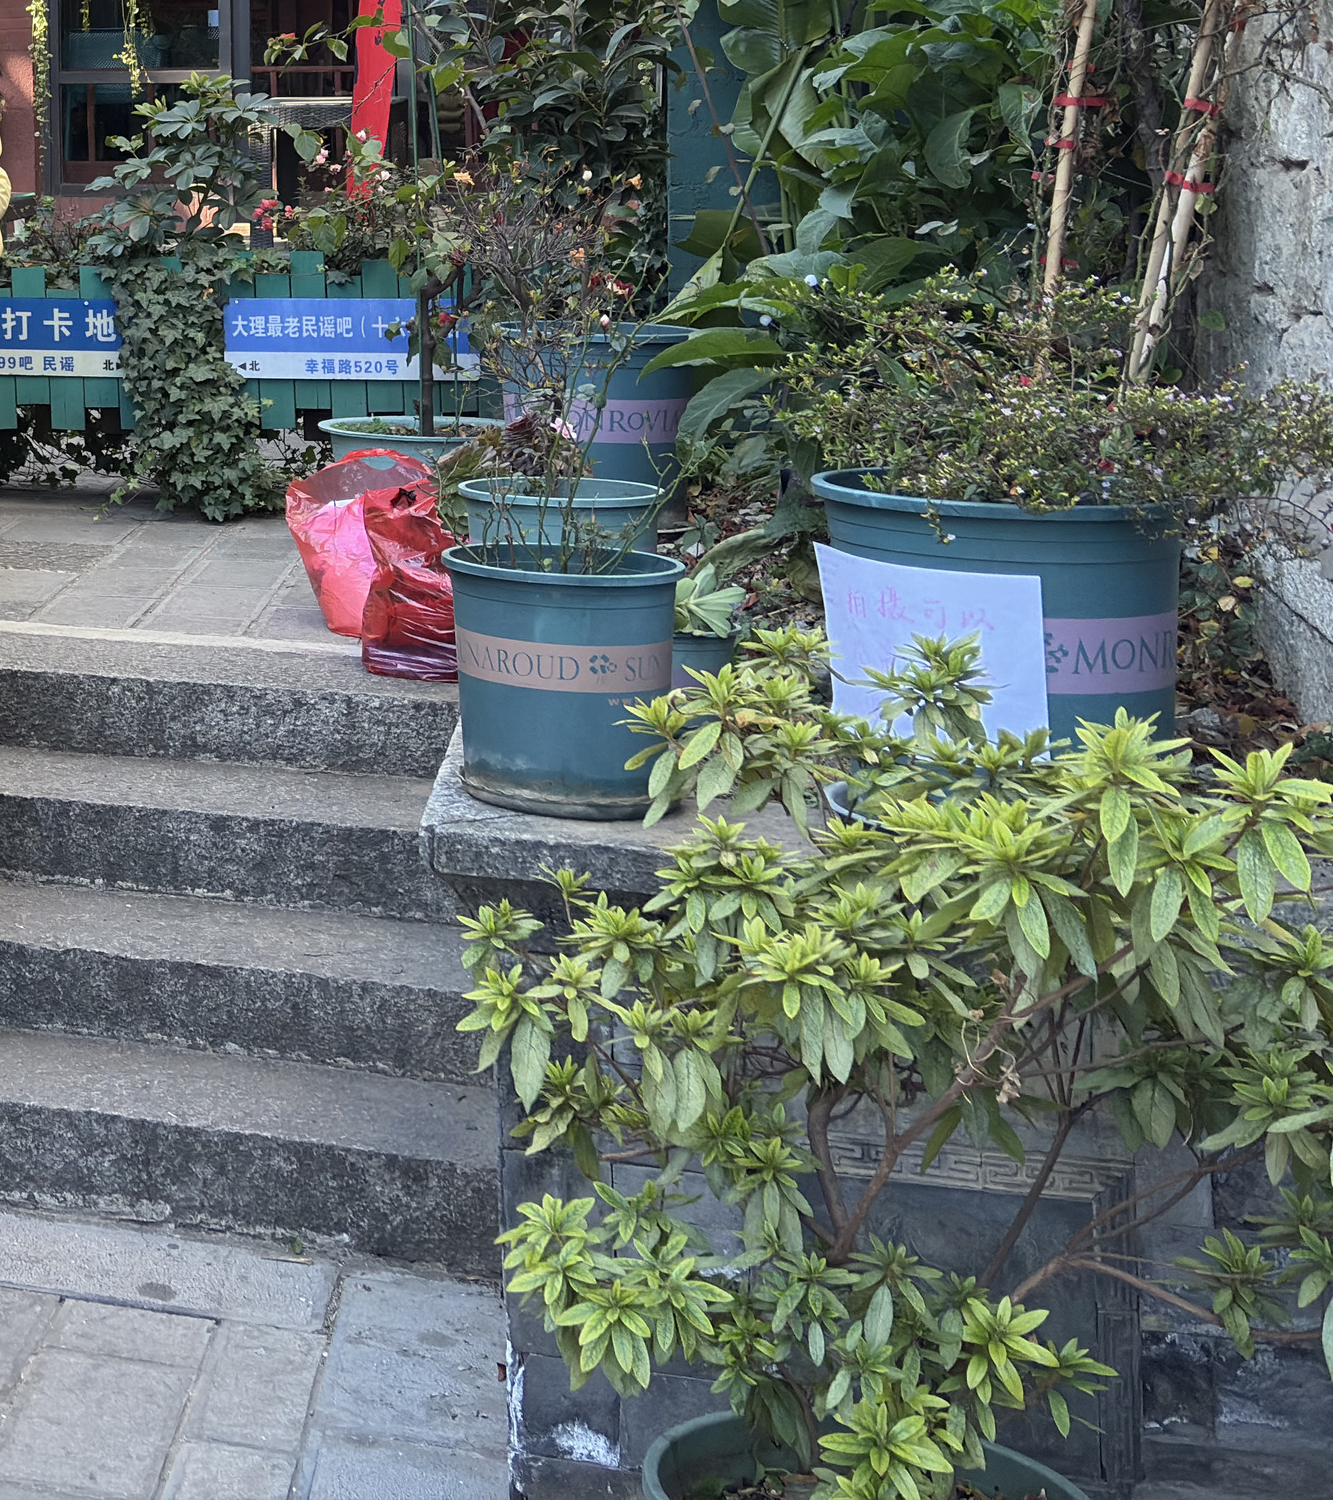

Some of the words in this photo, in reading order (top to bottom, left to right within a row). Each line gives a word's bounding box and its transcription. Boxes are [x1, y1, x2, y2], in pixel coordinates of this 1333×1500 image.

[43, 356, 75, 372] 民谣
[103, 359, 115, 371] 北
[248, 360, 261, 372] 北
[305, 358, 399, 375] 幸福路520号
[566, 409, 679, 434] ONROVI
[847, 586, 996, 631] 拍摄可以
